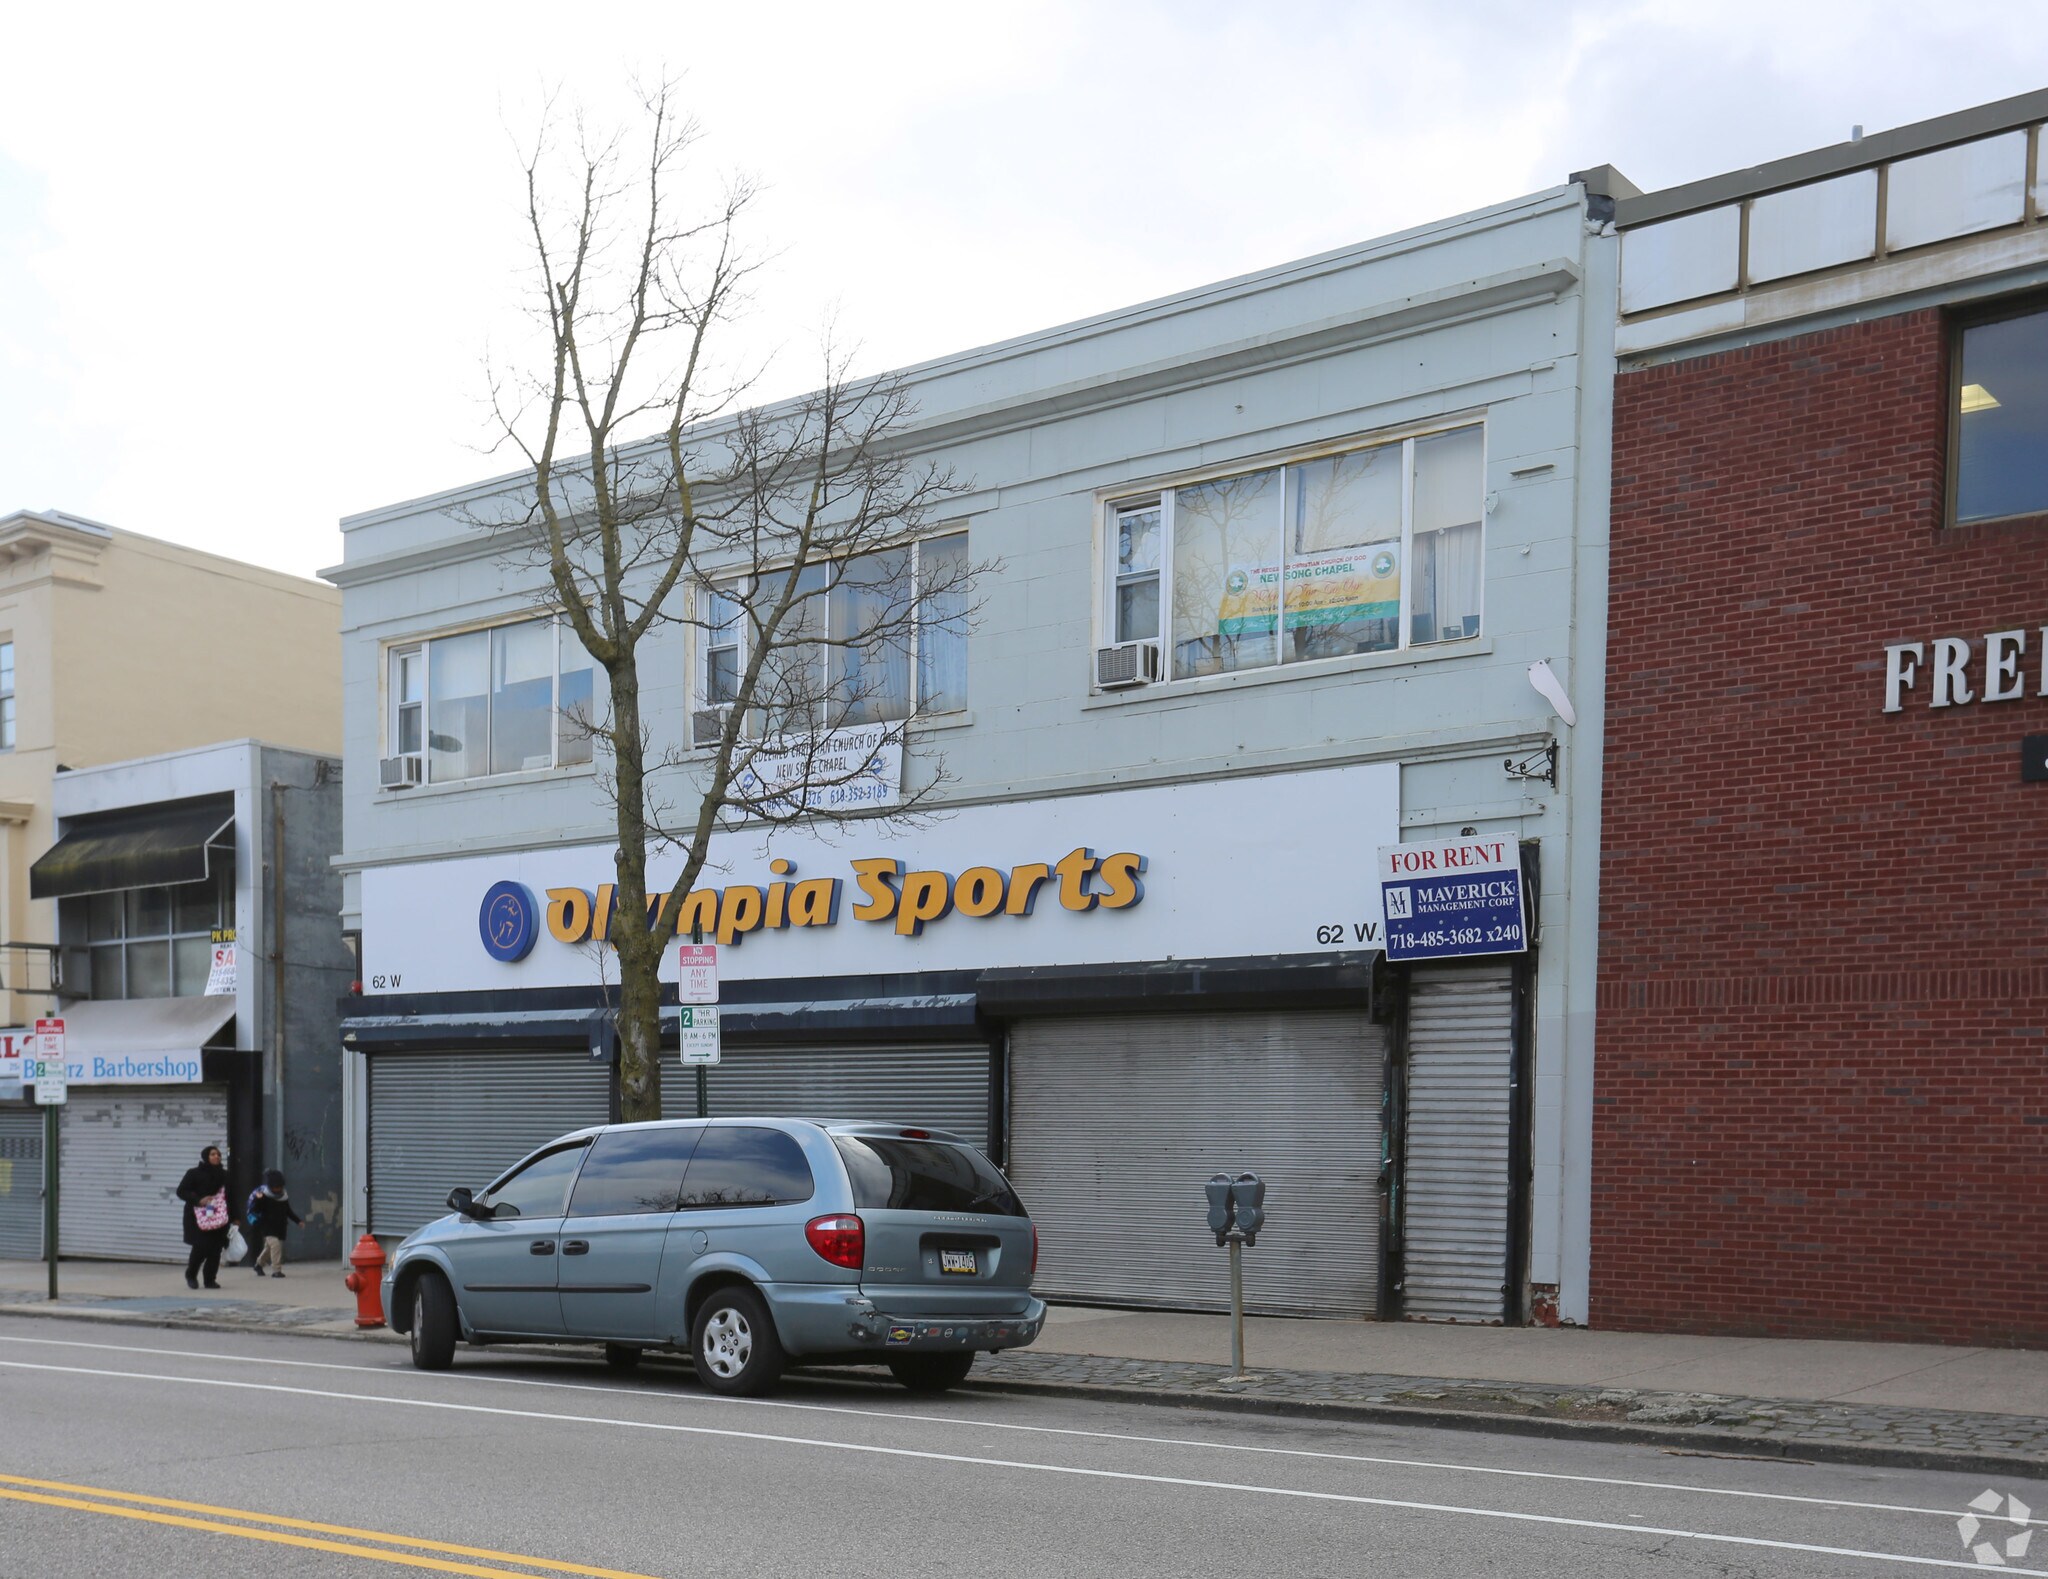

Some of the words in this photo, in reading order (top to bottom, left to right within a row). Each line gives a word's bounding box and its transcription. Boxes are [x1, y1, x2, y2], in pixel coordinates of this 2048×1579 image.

[1284, 568, 1312, 580] SONG
[1315, 563, 1354, 576] CHAPEL
[1882, 626, 2048, 713] FRE
[833, 735, 867, 753] CHURCH
[867, 733, 877, 749] OF
[776, 762, 794, 778] NEW
[795, 757, 817, 776] SOG
[818, 756, 848, 774] CHAPEL
[1390, 850, 1437, 873] FOR
[1443, 842, 1505, 868] RENT
[546, 858, 844, 951] Olmpia
[850, 847, 1147, 936] Sports
[1417, 880, 1515, 904] MAVERICK
[1417, 899, 1487, 914] MANAGEMENT
[1488, 896, 1515, 908] CORP
[1316, 924, 1344, 944] 62
[1390, 927, 1483, 950] 718-485-3682
[1486, 924, 1520, 942] x240
[215, 949, 236, 968] SA
[693, 947, 703, 955] NO
[682, 956, 714, 965] STOPPING
[372, 975, 386, 989] 62
[390, 974, 402, 988] W
[690, 969, 707, 978] ANY
[689, 979, 708, 989] TIME
[683, 1010, 691, 1026] 2
[693, 1017, 717, 1026] PARKING
[708, 1031, 717, 1039] PM
[38, 1064, 44, 1076] 2
[93, 1056, 198, 1081] Barbershop
